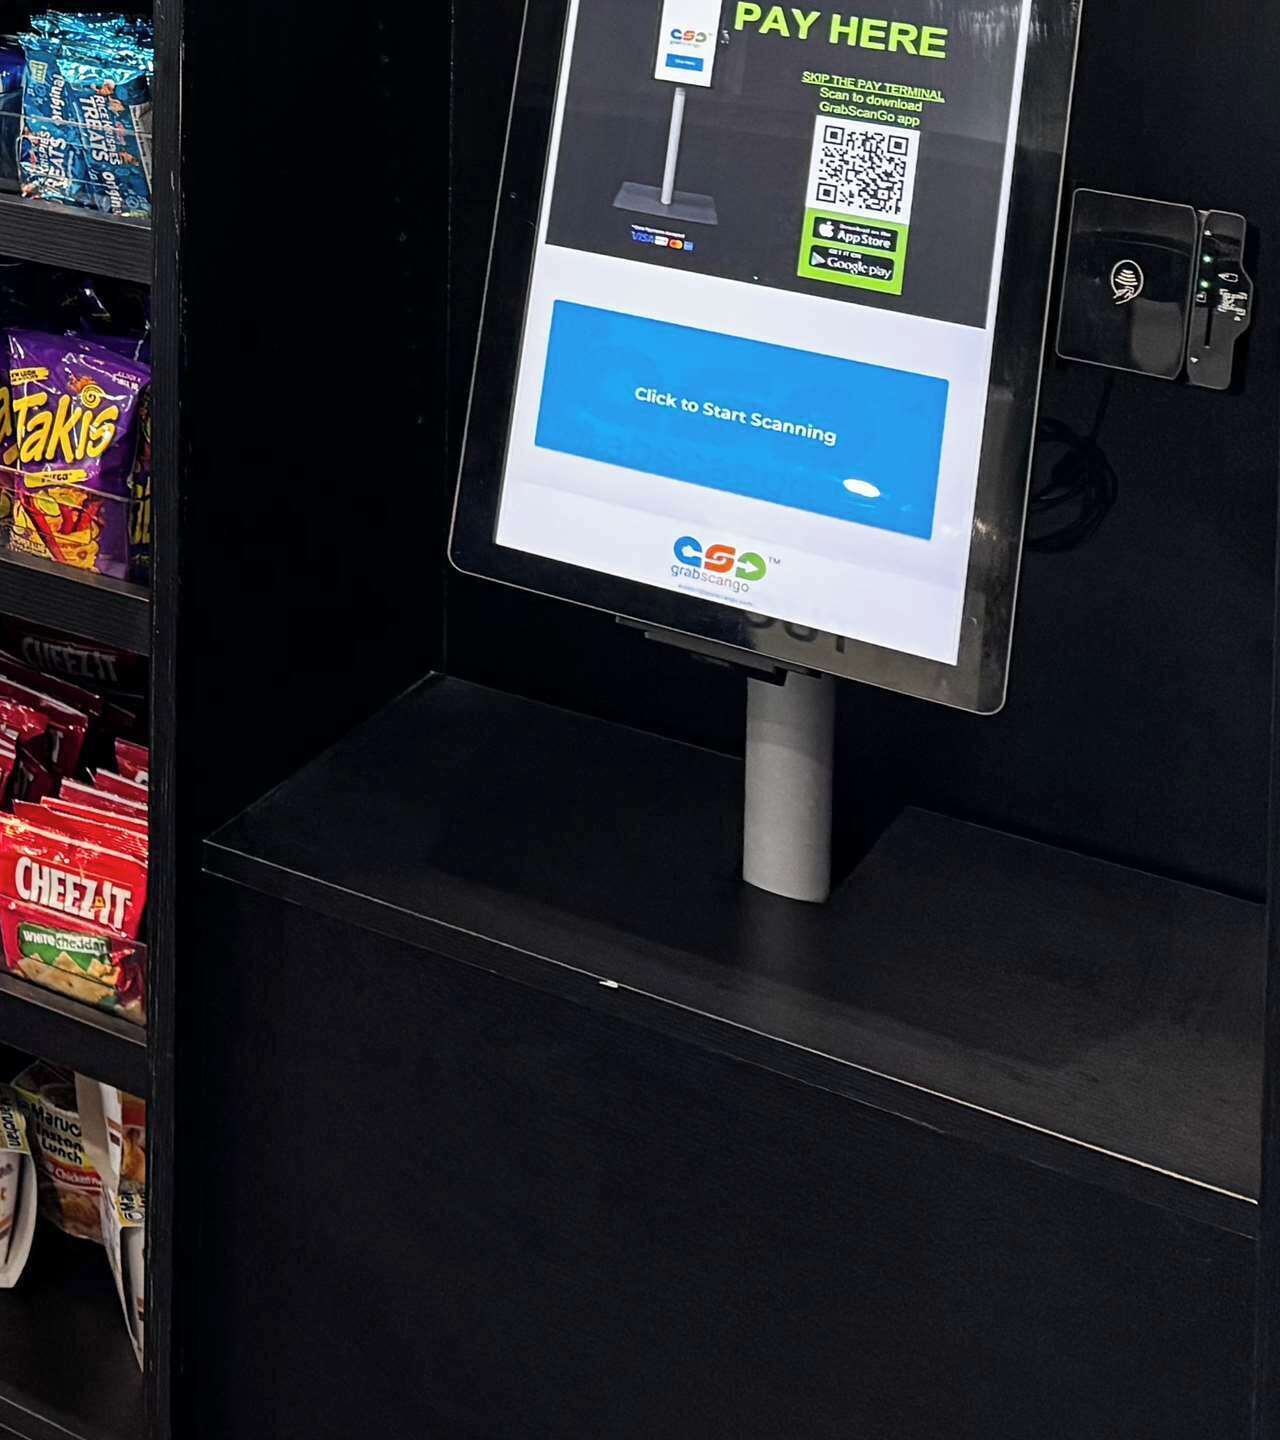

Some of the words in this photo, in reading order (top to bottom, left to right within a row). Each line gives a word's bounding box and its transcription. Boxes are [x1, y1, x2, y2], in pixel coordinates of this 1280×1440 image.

[733, 1, 822, 40] PAY
[829, 14, 949, 59] HERE
[803, 71, 832, 86] SKIP
[832, 75, 856, 89] THE
[858, 79, 883, 94] PAY
[884, 83, 946, 103] TERMINAL
[820, 87, 851, 103] Scan
[853, 92, 865, 104] to
[867, 94, 924, 113] download
[79, 97, 110, 162] TREATS
[820, 102, 896, 122] GrabScanGo
[899, 115, 921, 128] app
[838, 231, 861, 246] App
[863, 235, 892, 250] Store
[828, 258, 869, 276] Google
[869, 264, 893, 281] play
[11, 390, 120, 464] Takis
[636, 387, 678, 410] Click
[682, 399, 700, 414] to
[703, 403, 748, 425] Start
[750, 412, 837, 447] Scanning
[671, 563, 750, 593] grabscango
[41, 1142, 84, 1167] Lunch
